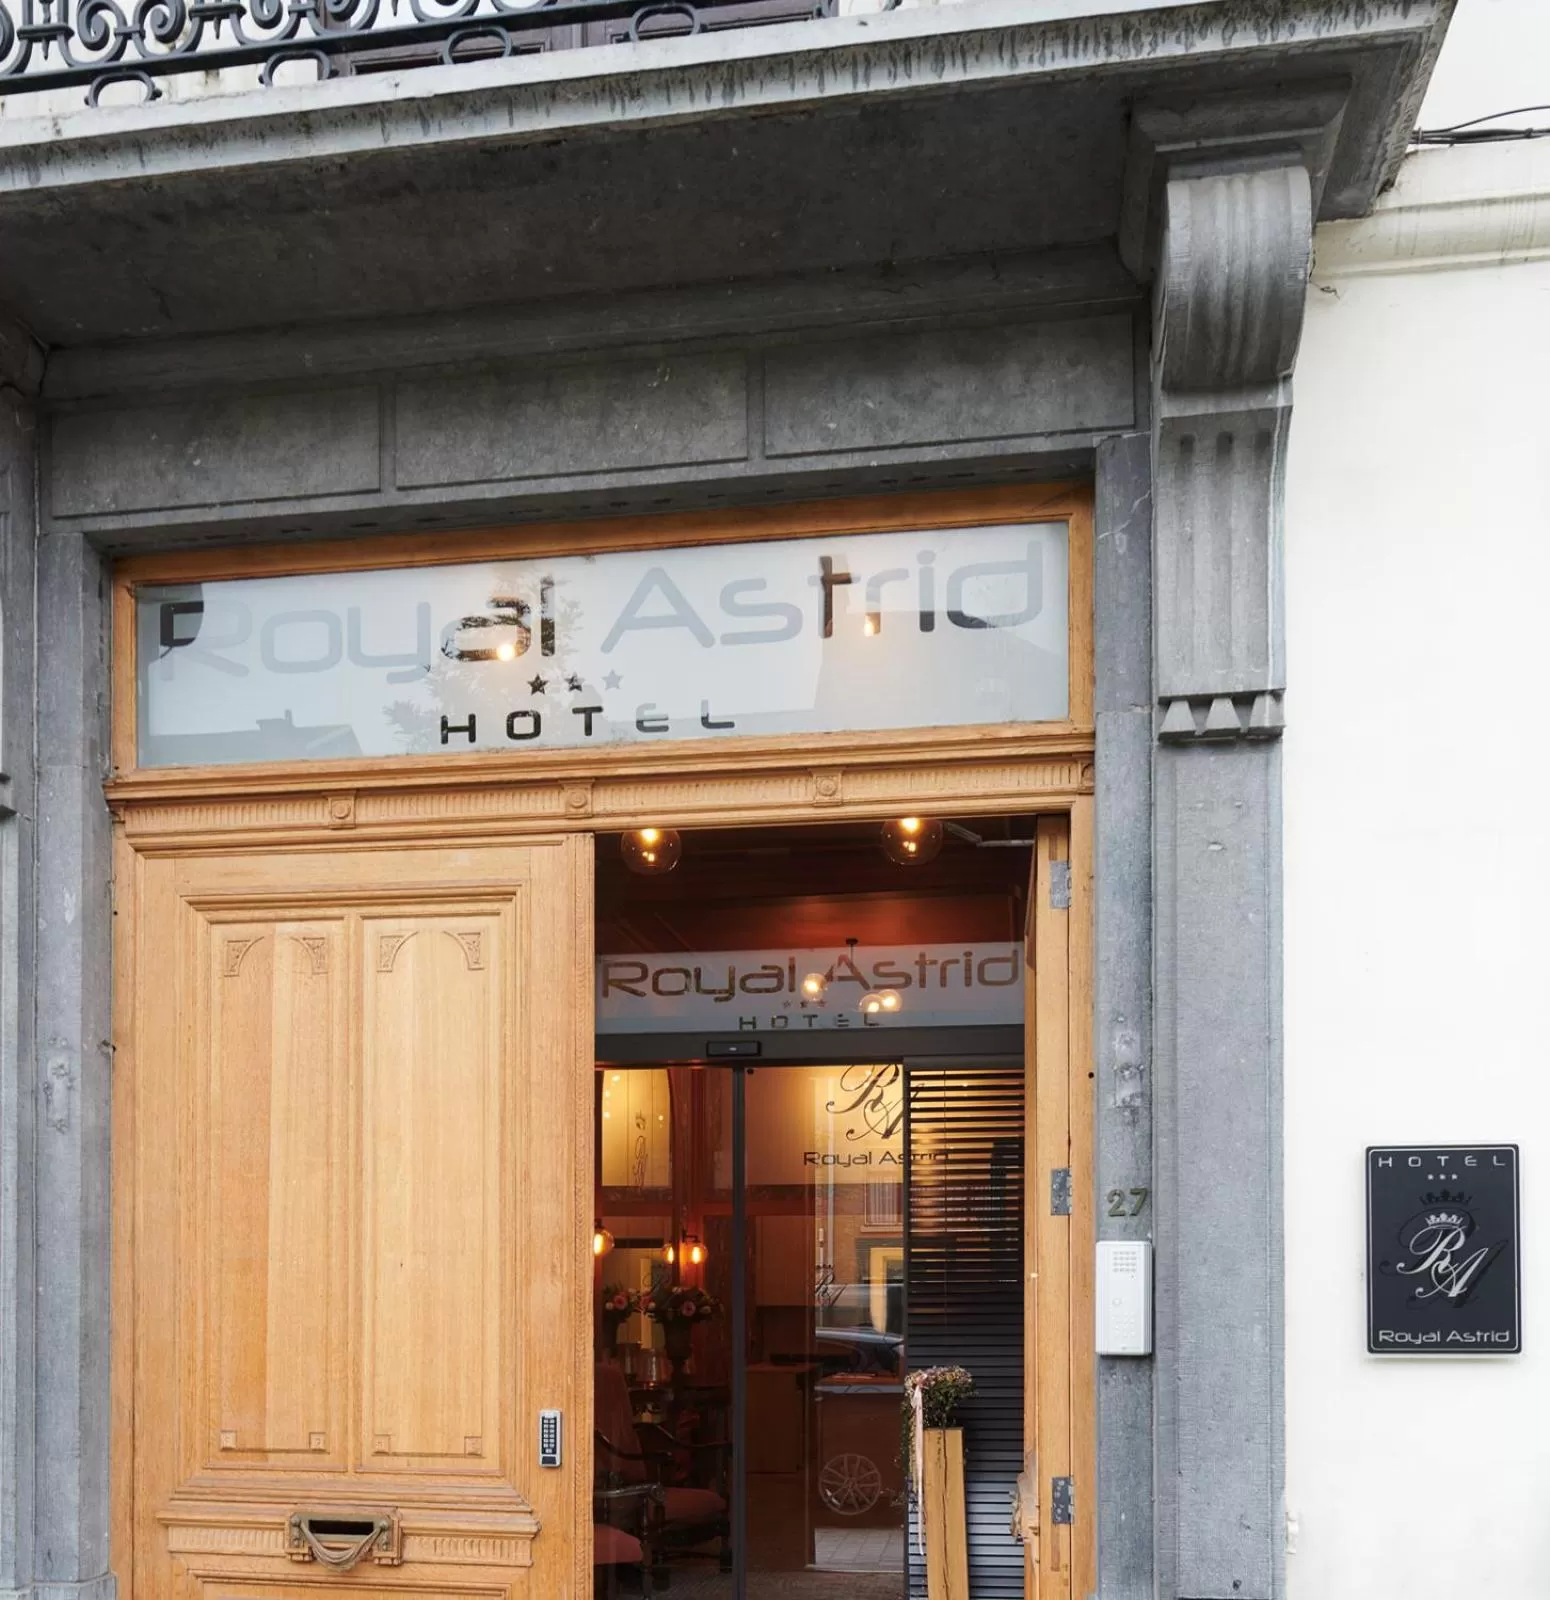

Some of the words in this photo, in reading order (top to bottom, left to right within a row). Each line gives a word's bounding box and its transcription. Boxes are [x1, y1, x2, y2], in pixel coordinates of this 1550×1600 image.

[159, 575, 555, 685] Royal
[600, 540, 1043, 654] Astrid
[440, 699, 735, 744] HOTEL
[601, 955, 796, 1002] Royal
[826, 949, 1019, 990] Astrid
[739, 1013, 879, 1030] HOTEL
[804, 1151, 872, 1167] Royal
[1378, 1155, 1506, 1168] HOTEL
[1107, 1187, 1149, 1218] 27
[1378, 1329, 1441, 1345] Royal
[1446, 1329, 1510, 1343] Astrid
